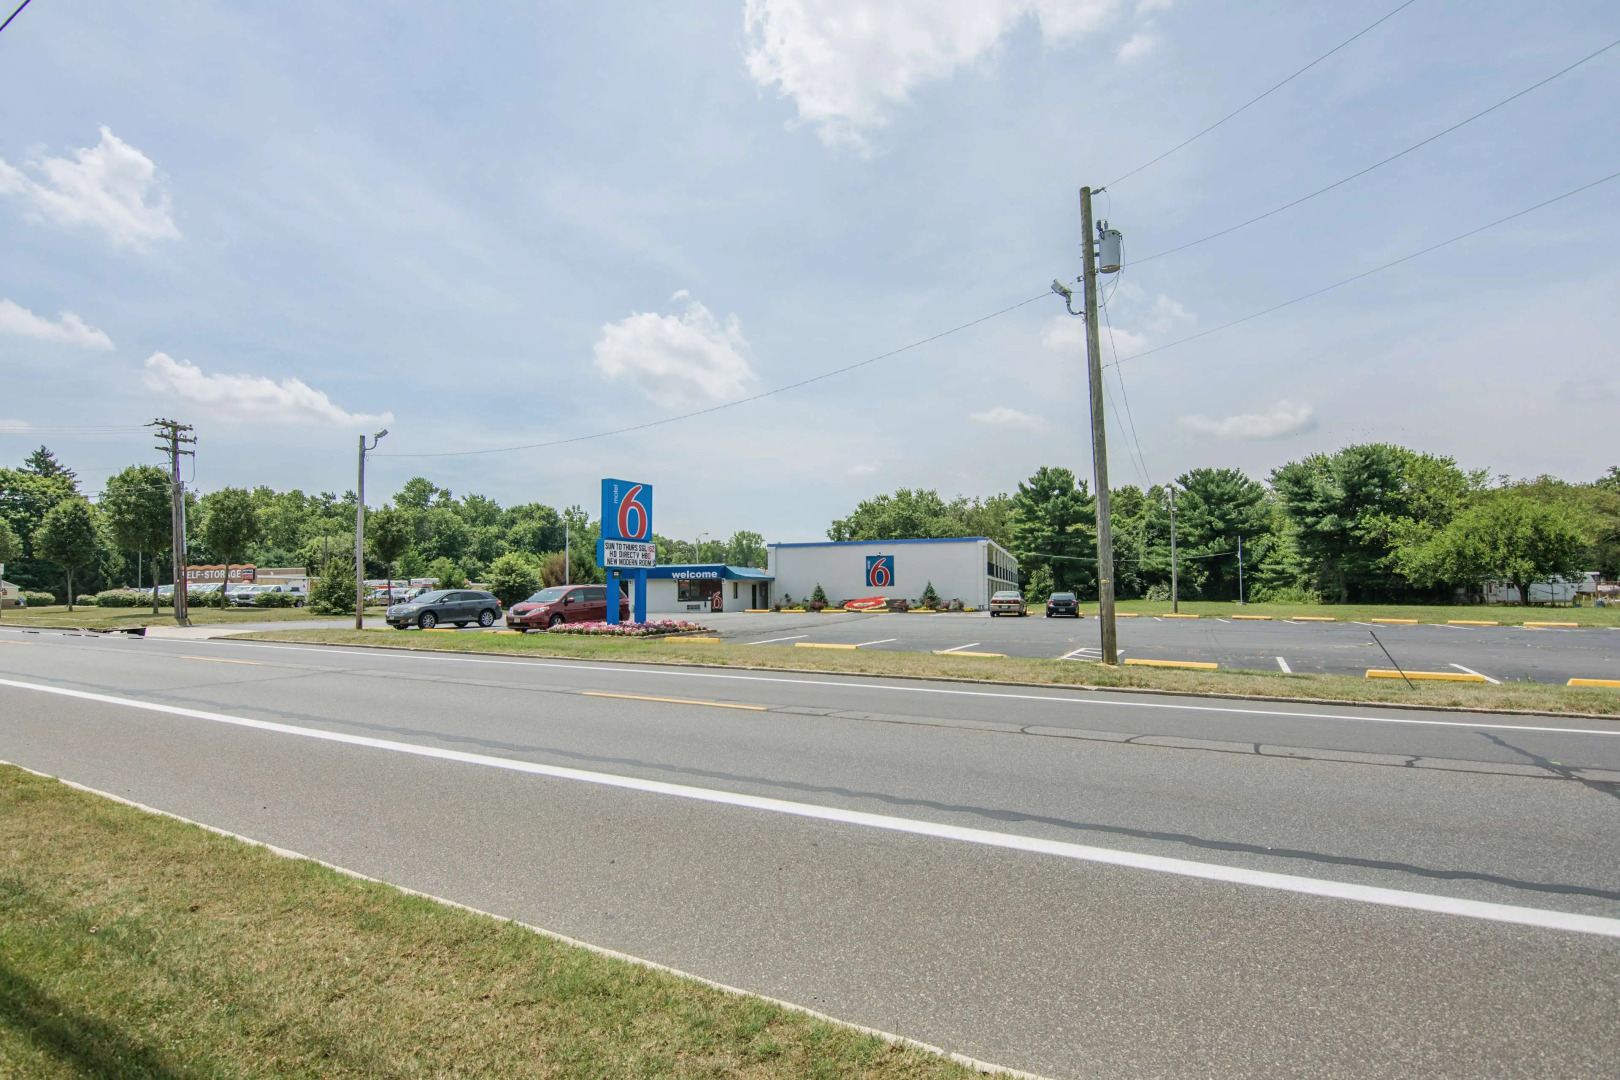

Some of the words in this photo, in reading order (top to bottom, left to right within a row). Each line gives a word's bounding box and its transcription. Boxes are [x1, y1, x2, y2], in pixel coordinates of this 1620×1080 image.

[617, 484, 648, 539] 6
[616, 543, 622, 551] TO
[623, 544, 638, 552] THURS
[609, 550, 617, 558] HD
[641, 552, 652, 560] HBO
[606, 558, 618, 566] NEW
[619, 559, 638, 567] MODERN
[182, 569, 242, 579] ELF-STORGE
[671, 570, 718, 579] welcome
[870, 557, 891, 587] 6
[711, 591, 723, 609] 6
